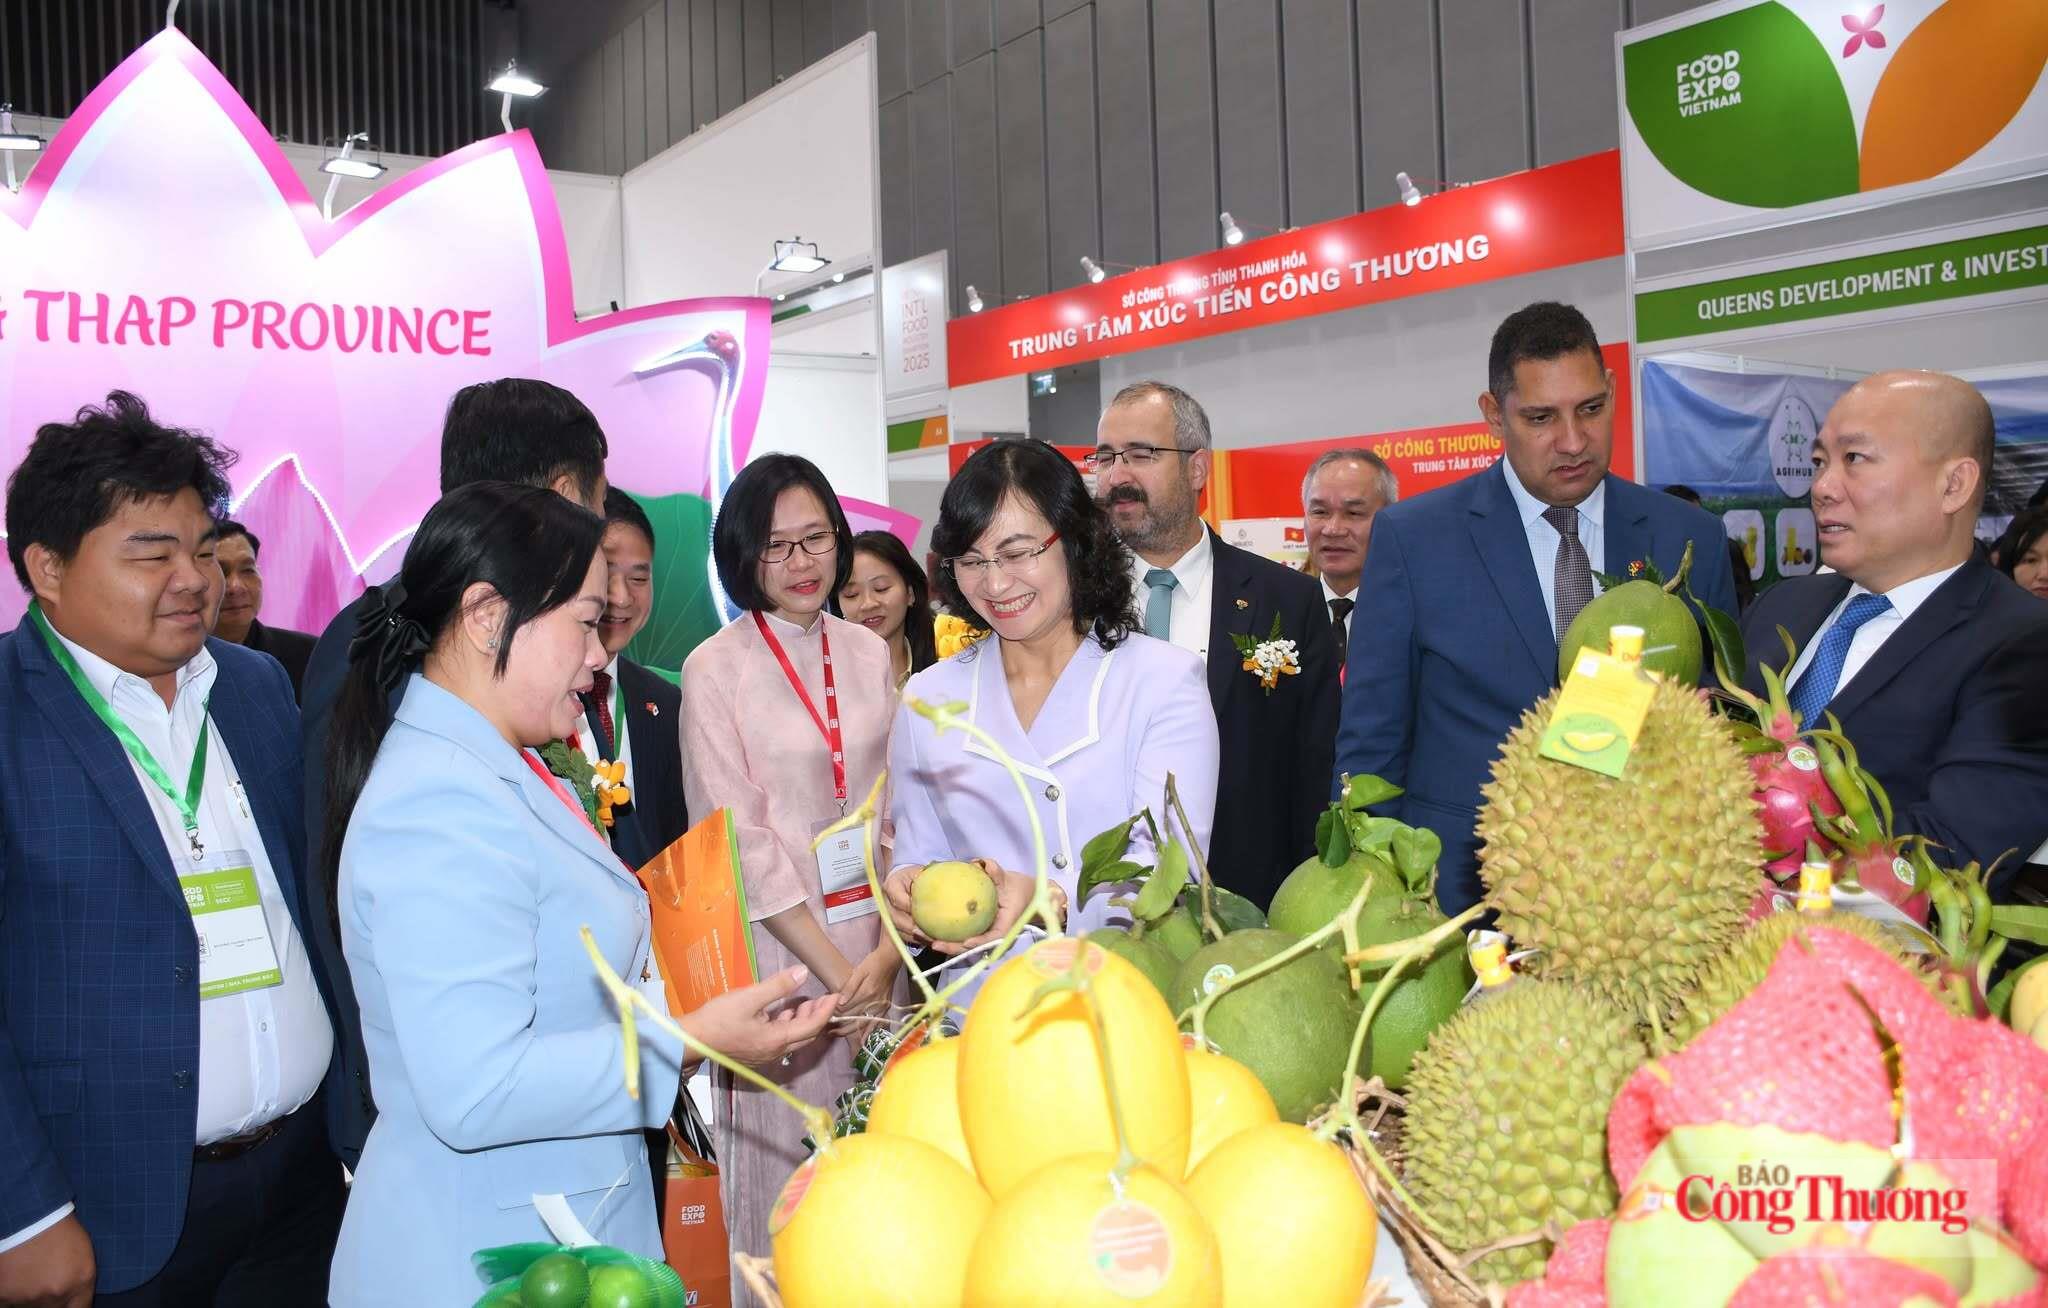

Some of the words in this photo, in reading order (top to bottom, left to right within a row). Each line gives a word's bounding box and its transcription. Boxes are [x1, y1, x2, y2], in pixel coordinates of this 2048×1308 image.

[1677, 50, 1740, 83] FOOD
[1678, 70, 1740, 104] EXPO
[1679, 91, 1741, 117] VIETNAM
[1122, 289, 1136, 308] SỞ
[1137, 286, 1165, 305] CÔNG
[1240, 257, 1279, 279] THANH
[1282, 250, 1308, 270] HÓA
[1698, 290, 1774, 320] QUEENS
[1780, 263, 1934, 307] DEVELOPMENT
[1941, 260, 1957, 282] &
[1009, 328, 1077, 359] TRUNG
[1083, 315, 1132, 342] TÂM
[1139, 302, 1186, 332] XÚC
[1193, 284, 1252, 318] TIẾN
[1260, 268, 1341, 305] CÔNG
[1349, 234, 1489, 285] THƯƠNG
[24, 289, 197, 347] THAP
[211, 297, 492, 356] PROVINCE
[903, 352, 930, 374] 2025
[1373, 438, 1392, 459] SỞ
[1394, 437, 1434, 458] CÔNG
[1438, 433, 1501, 455] THƯƠNG
[1412, 460, 1446, 474] TRUNG
[1447, 456, 1470, 471] TÂM
[1471, 454, 1493, 469] XÚC
[682, 1205, 705, 1213] FOOD
[682, 1212, 705, 1220] EXPO
